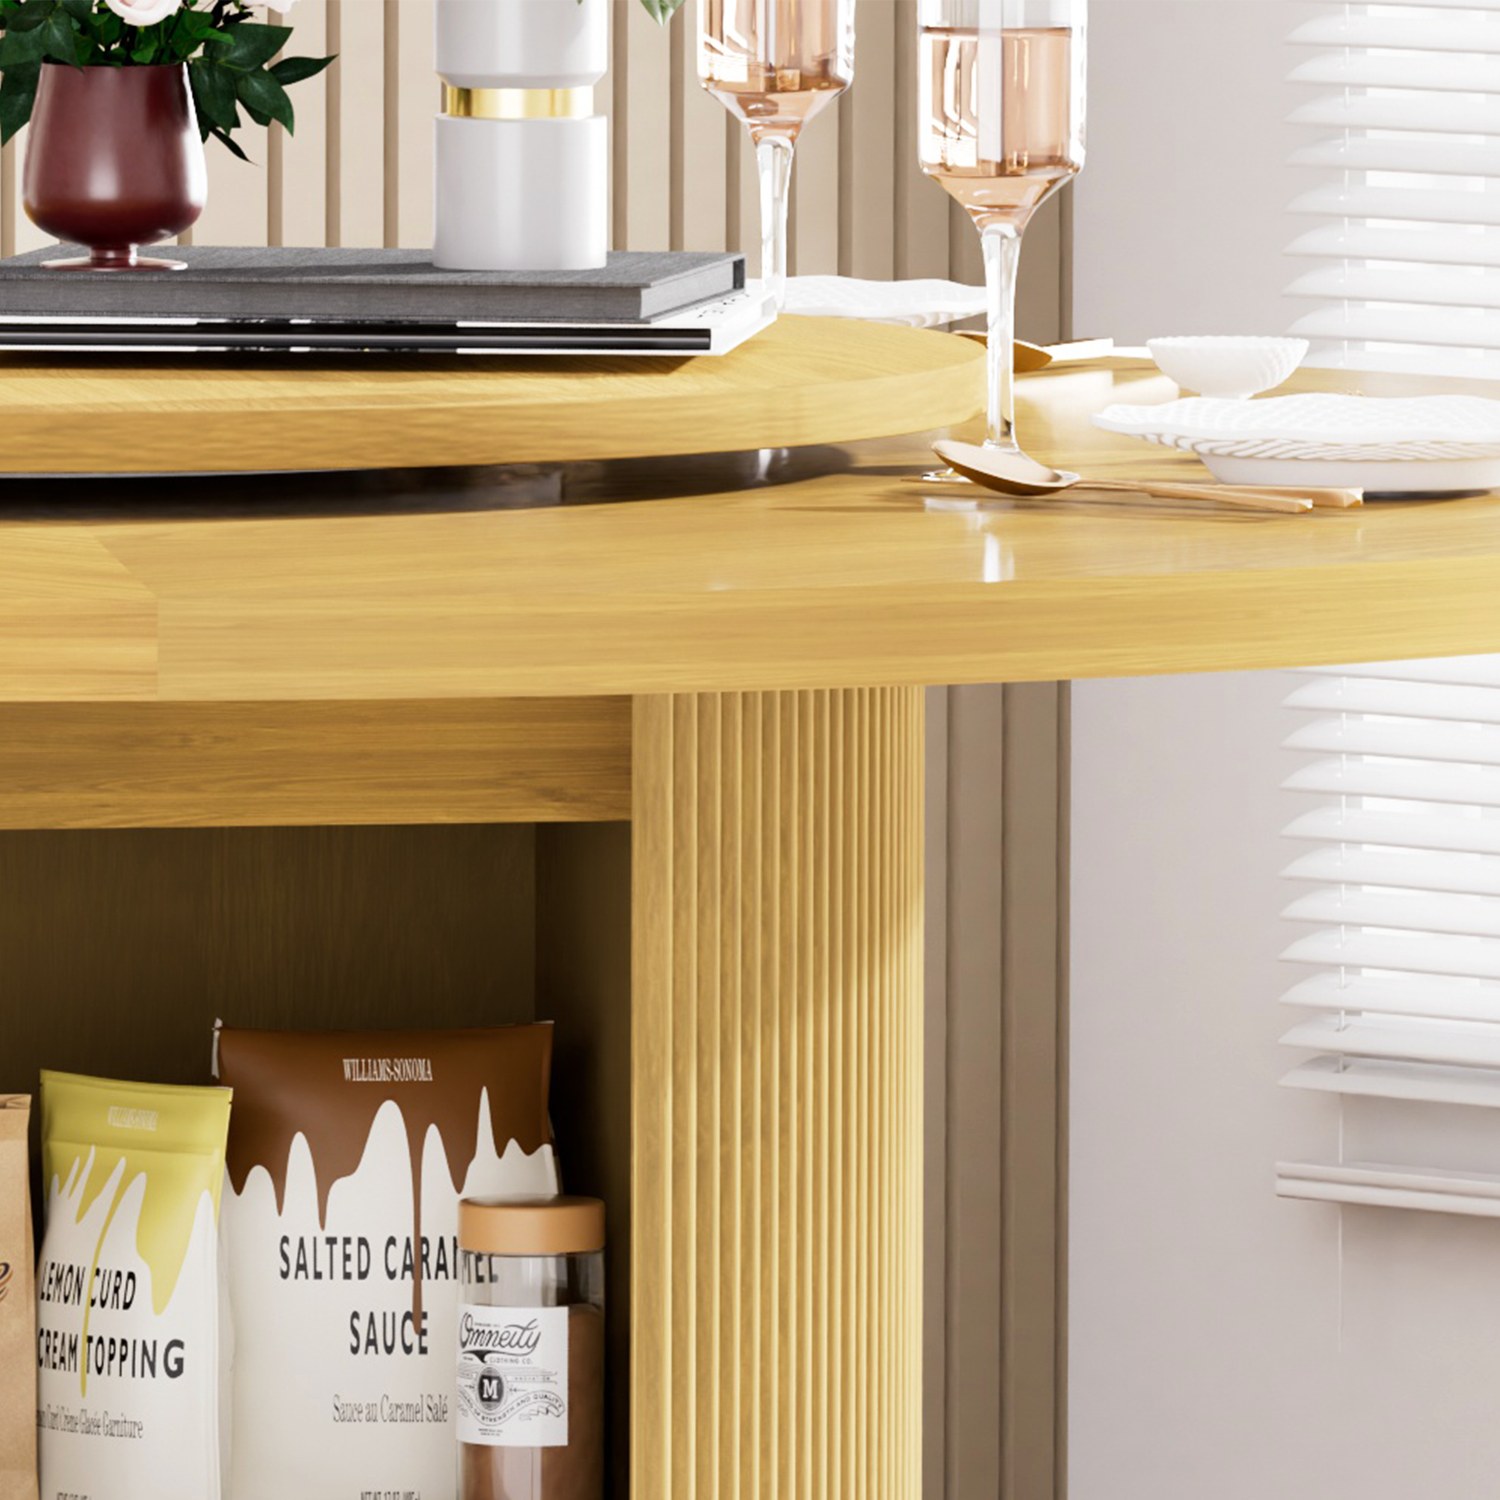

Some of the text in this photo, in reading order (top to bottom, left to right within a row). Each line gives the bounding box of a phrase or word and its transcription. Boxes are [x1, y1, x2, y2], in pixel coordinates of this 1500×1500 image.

[342, 1058, 433, 1082] WILLIAMS-SONOMA
[279, 1234, 371, 1281] SALTED
[40, 1260, 86, 1306] LEMON
[349, 1310, 429, 1356] SAUCE
[37, 1327, 185, 1379] CREAM TOPPING
[482, 1378, 499, 1399] M
[102, 1410, 143, 1439] Garniture
[333, 1393, 363, 1423] Sauce
[365, 1402, 378, 1423] au
[380, 1393, 424, 1423] Caramel
[426, 1393, 448, 1423] Salé
